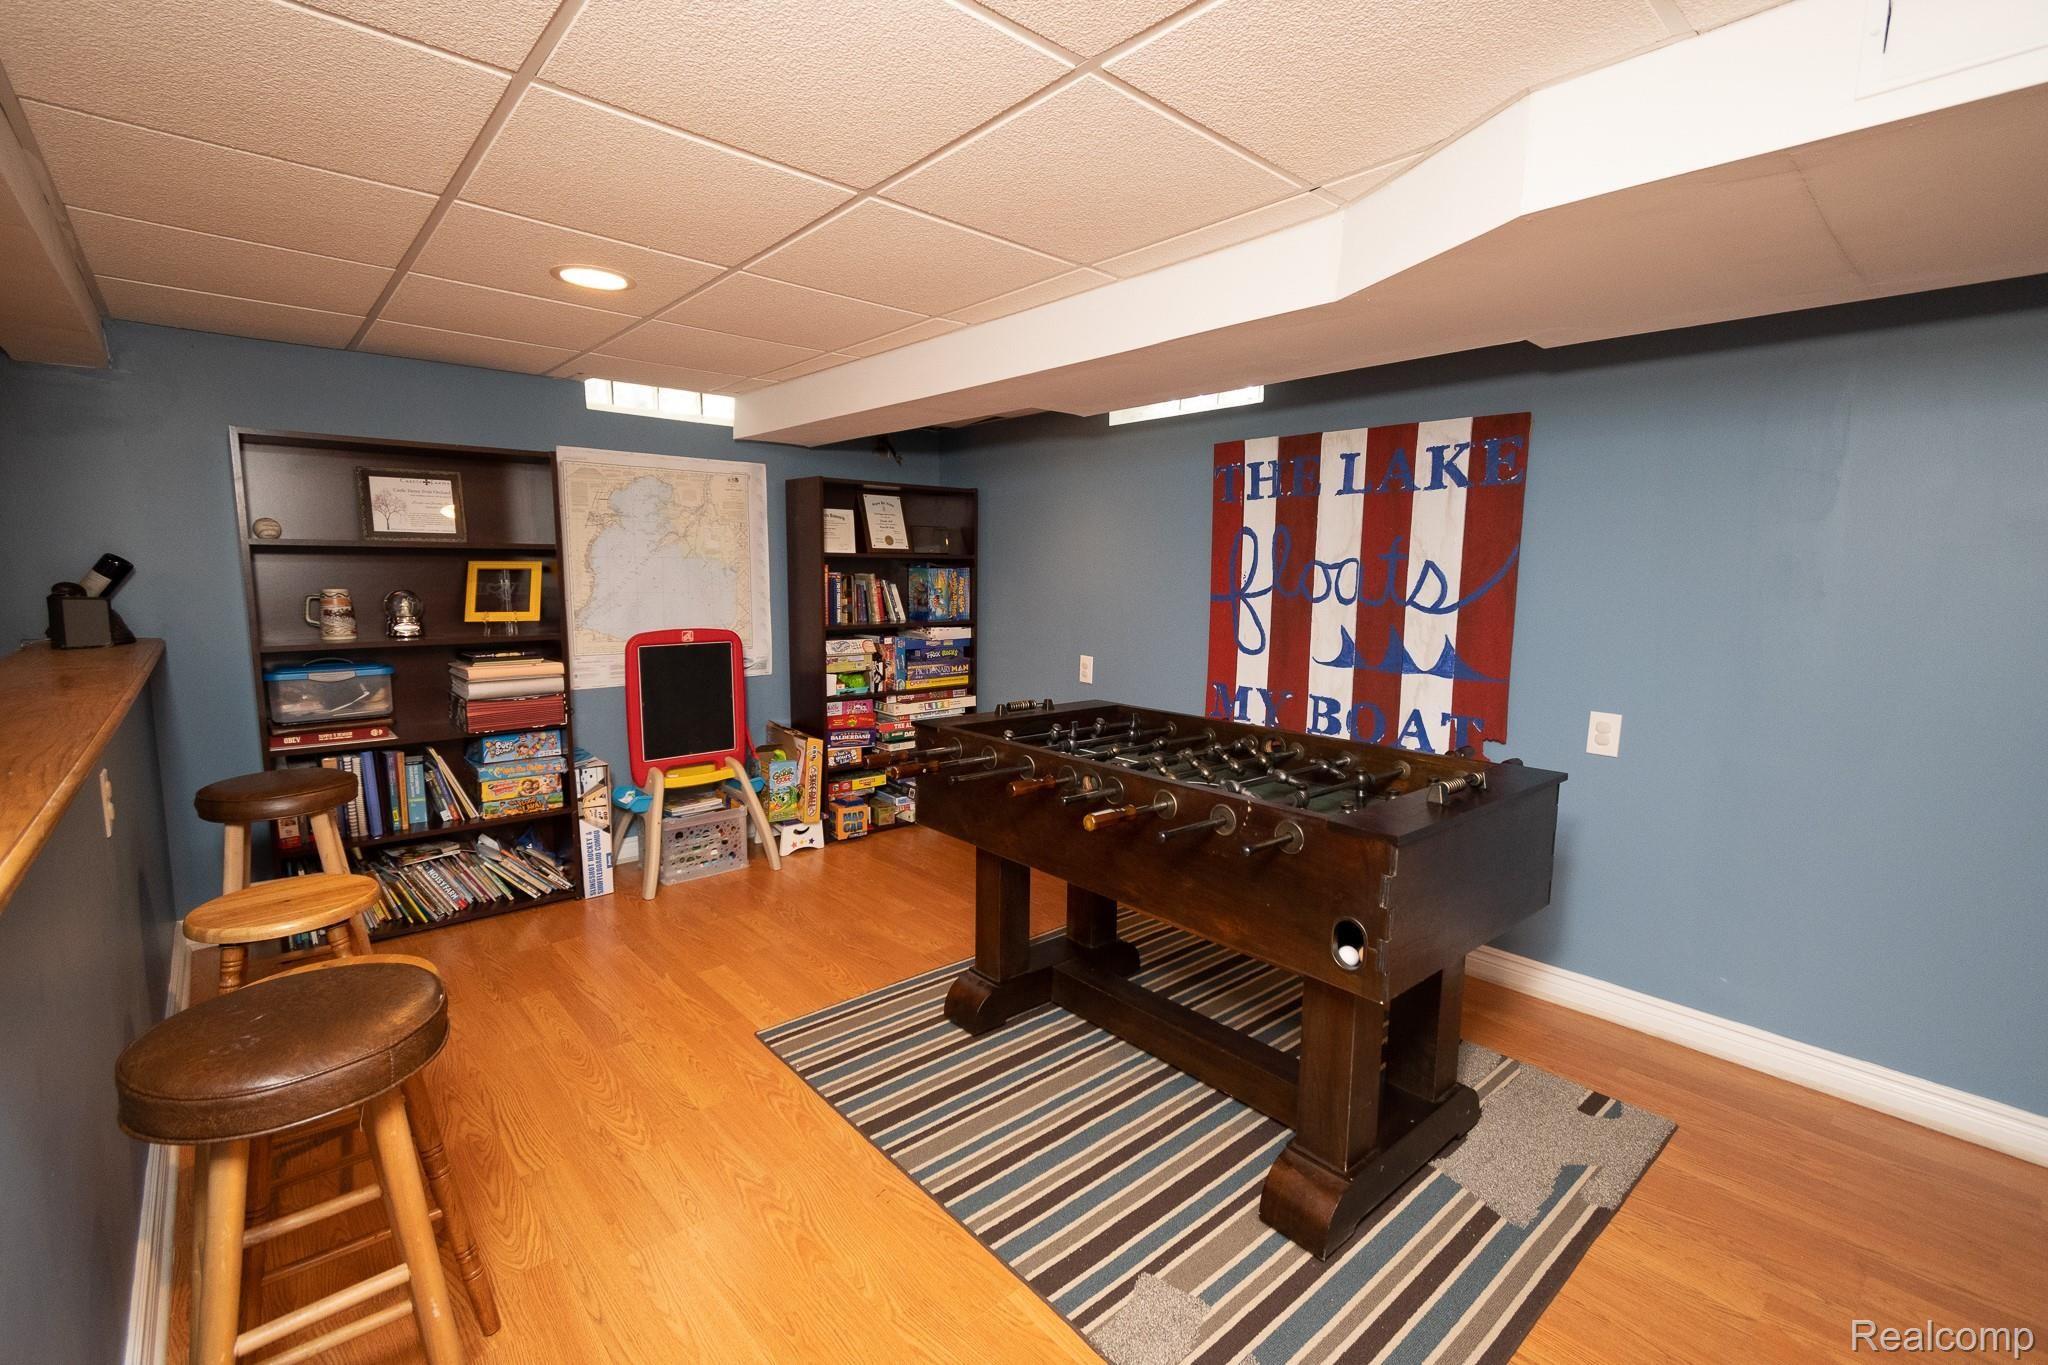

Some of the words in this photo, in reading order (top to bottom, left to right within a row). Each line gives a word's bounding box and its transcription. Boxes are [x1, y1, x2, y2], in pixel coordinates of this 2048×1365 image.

[1214, 458, 1322, 503] THE
[1335, 437, 1524, 496] LAKE
[1210, 526, 1520, 655] floats
[951, 664, 969, 672] MAN
[1210, 680, 1295, 728] MY
[1306, 694, 1485, 755] BOAT
[843, 810, 864, 821] MAD
[586, 838, 594, 862] HOCKEY
[587, 863, 597, 896] SLINGSHOT
